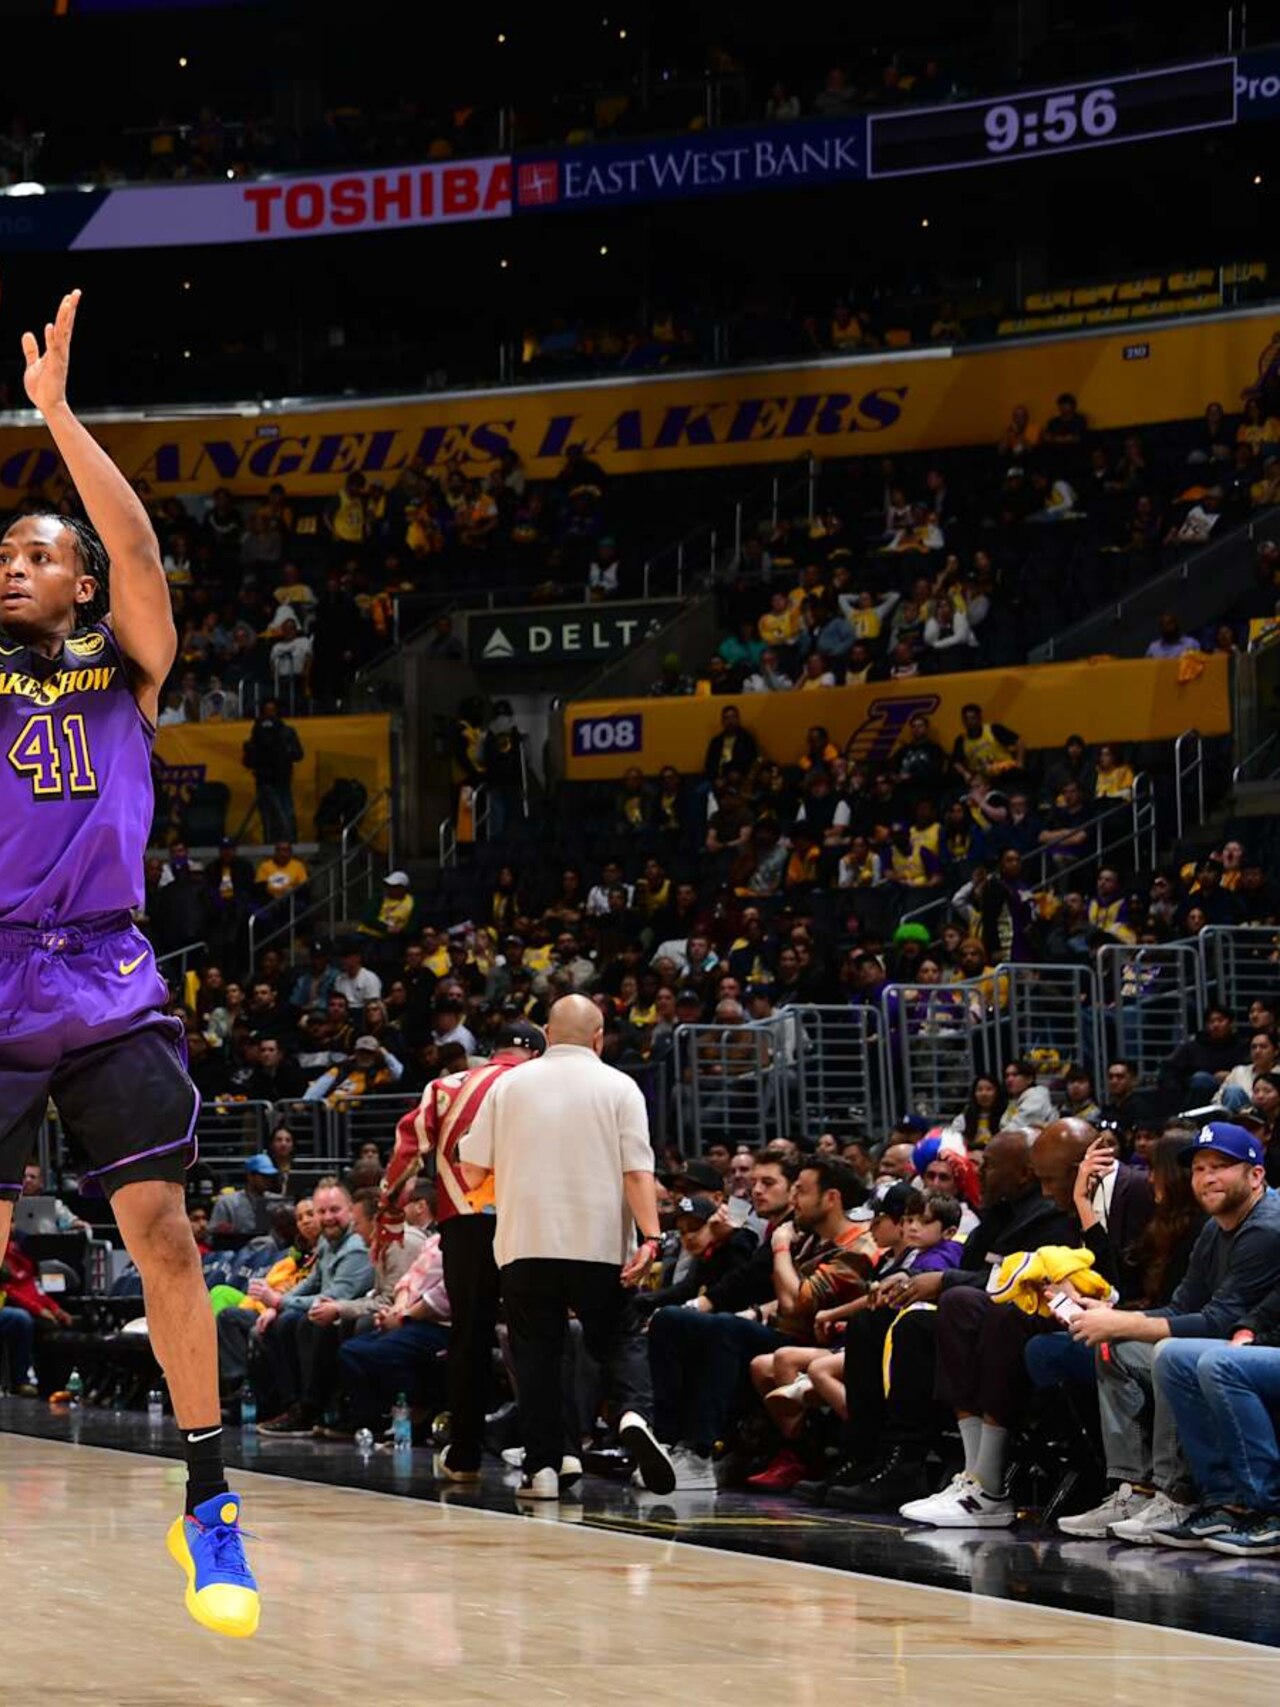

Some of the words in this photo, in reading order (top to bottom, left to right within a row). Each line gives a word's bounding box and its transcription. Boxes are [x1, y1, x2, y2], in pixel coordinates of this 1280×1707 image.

[983, 88, 1118, 153] 9:56
[244, 163, 511, 232] TOSHIBA
[135, 419, 516, 483] ANGELES
[534, 386, 910, 458] LAKERS
[7, 713, 99, 801] 41
[578, 719, 635, 752] 108
